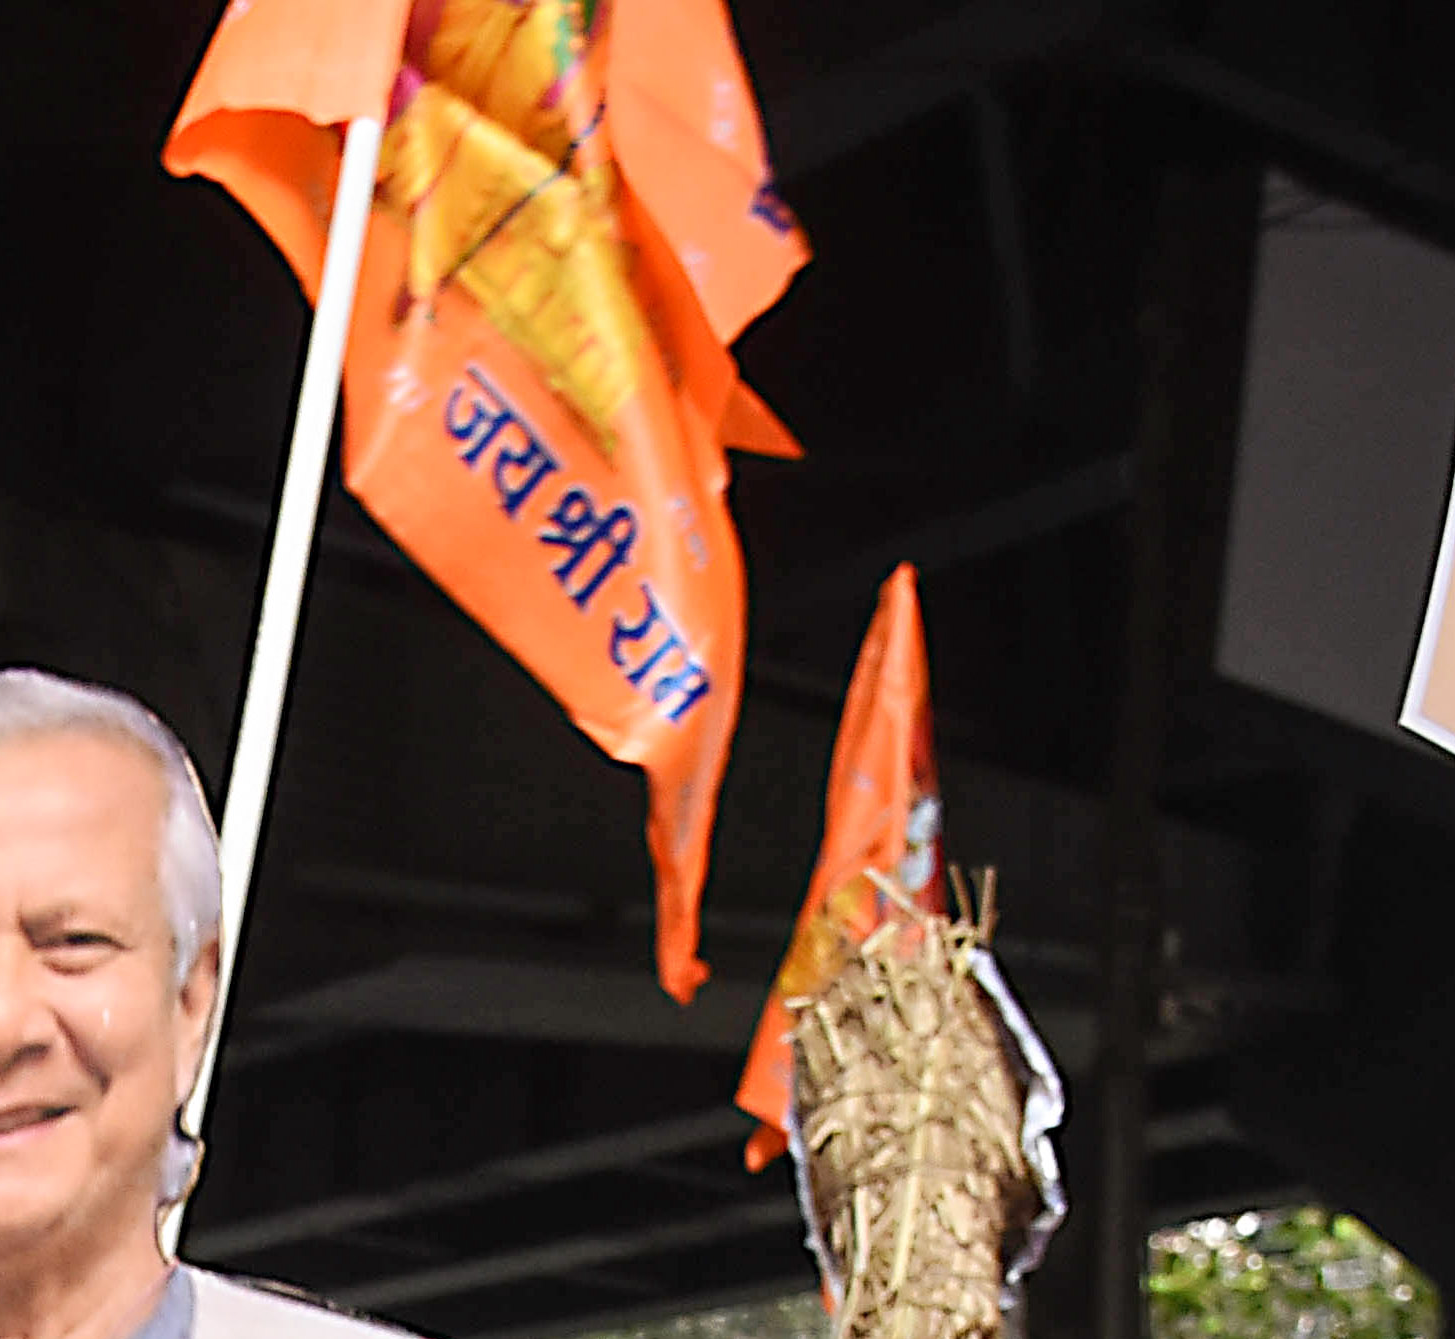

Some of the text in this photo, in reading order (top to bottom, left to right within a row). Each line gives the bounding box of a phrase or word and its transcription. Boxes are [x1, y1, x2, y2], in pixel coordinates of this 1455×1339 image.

[444, 366, 712, 724] जय श्री राम
